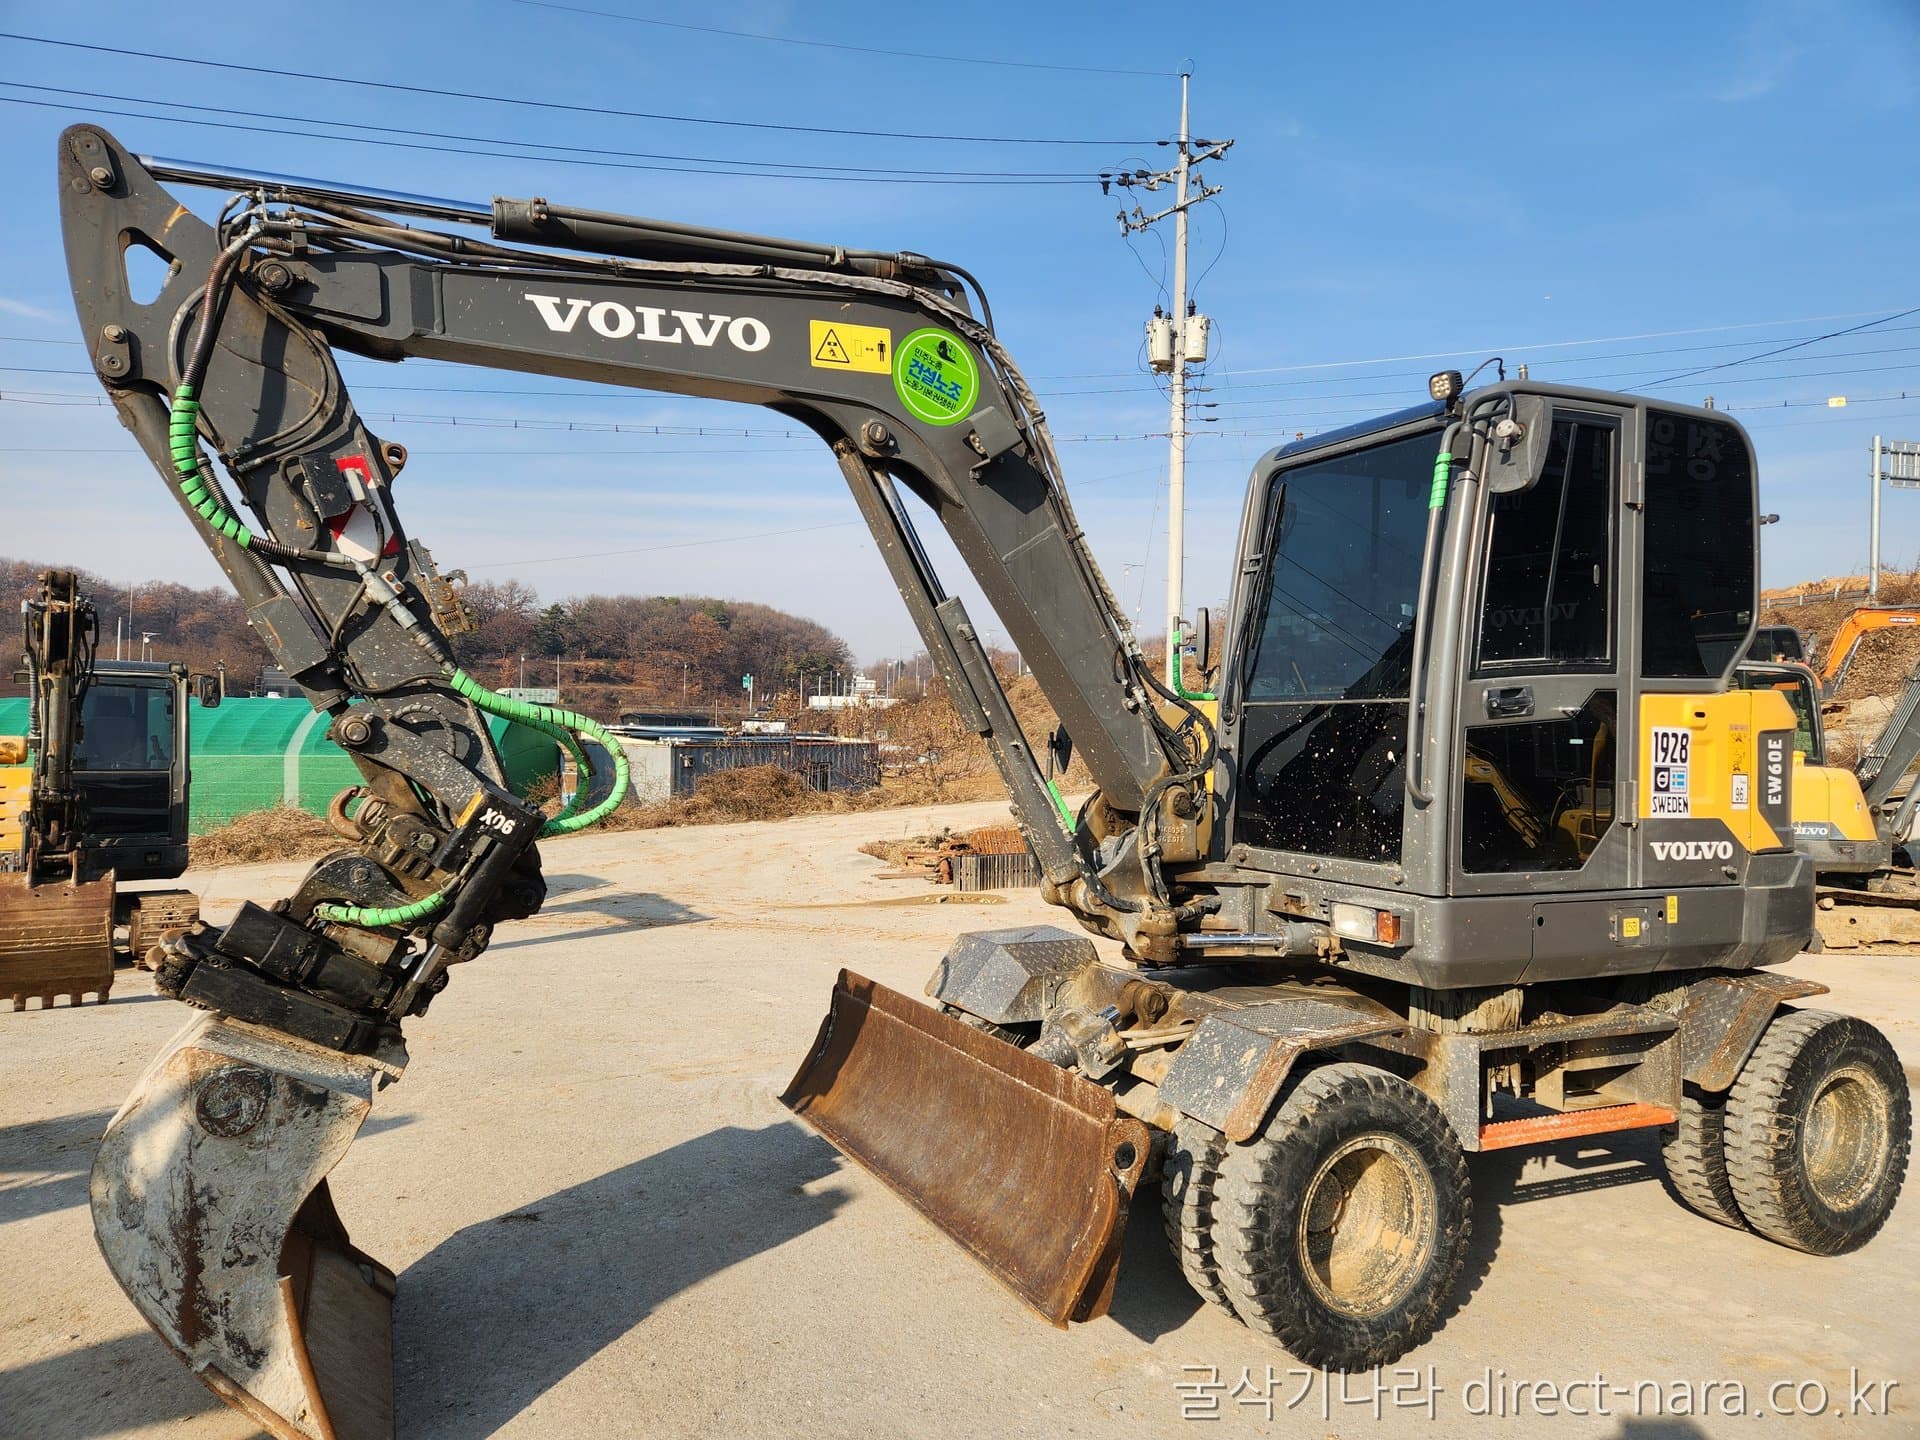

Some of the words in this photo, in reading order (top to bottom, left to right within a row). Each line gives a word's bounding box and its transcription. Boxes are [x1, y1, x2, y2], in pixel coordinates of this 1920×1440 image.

[525, 294, 771, 352] VOLVO
[908, 357, 963, 402] 건설노조
[1654, 732, 1690, 764] 1928
[1767, 739, 1783, 805] EW60E
[1652, 796, 1689, 813] SWEDEN
[1735, 787, 1744, 801] 96
[1650, 841, 1734, 861] VOLVO
